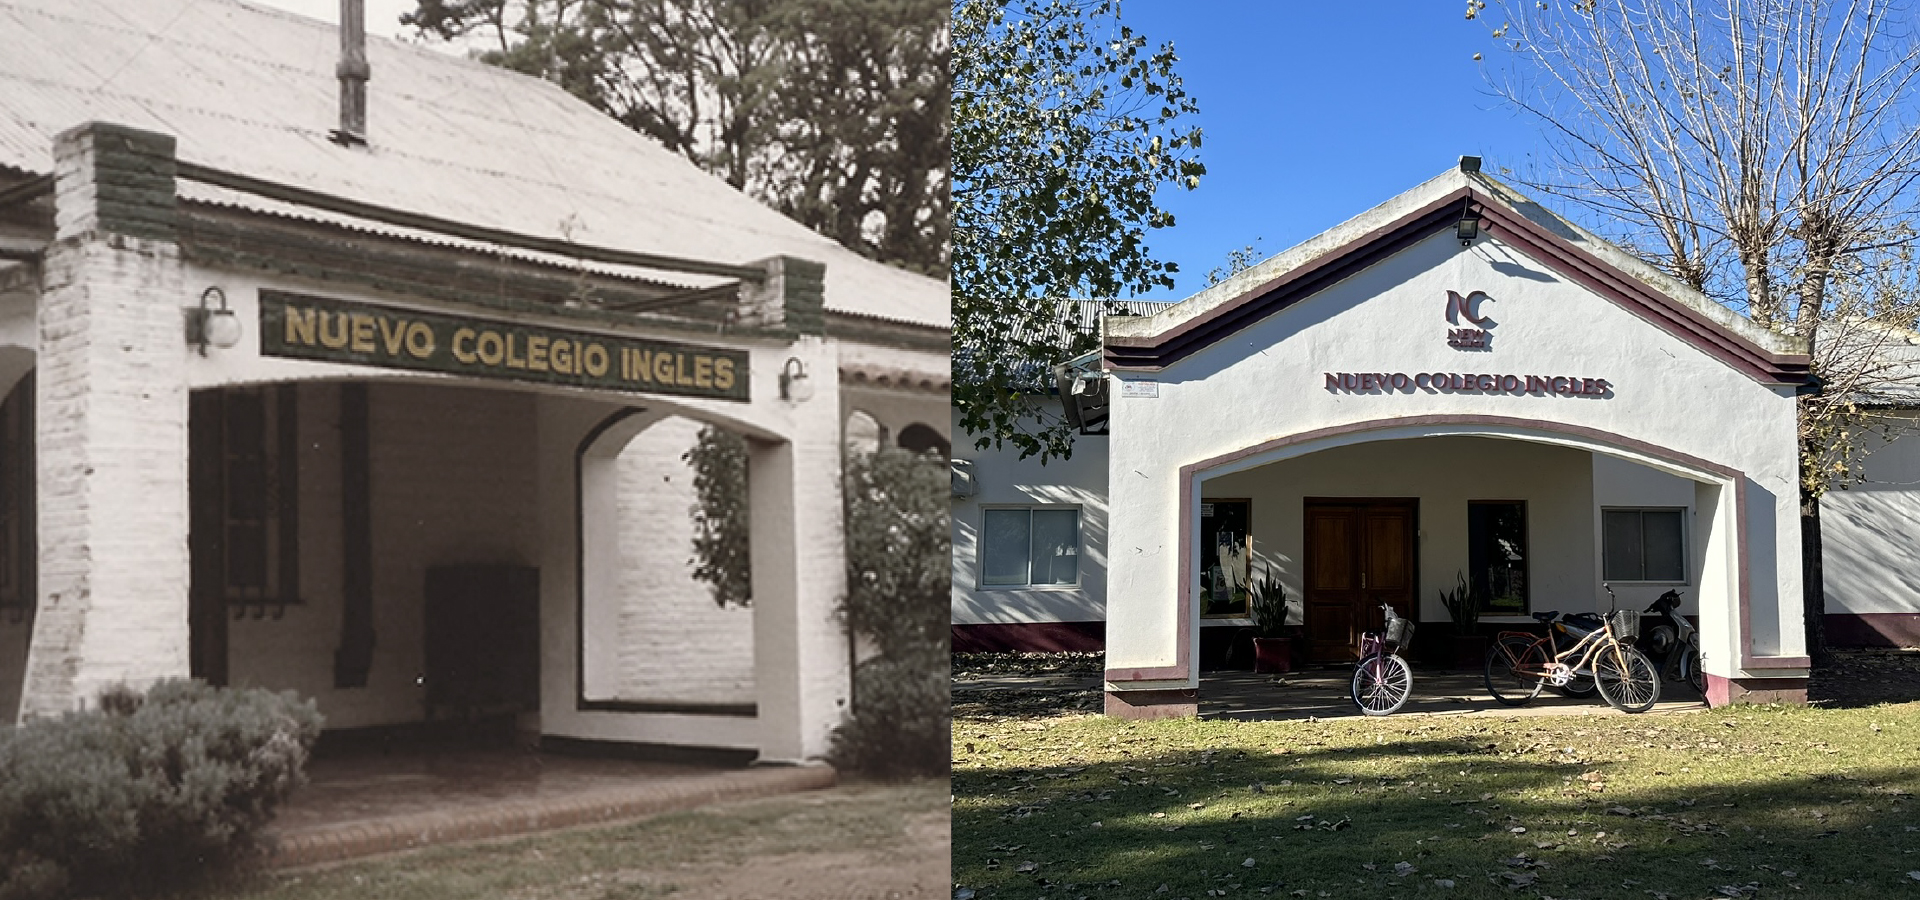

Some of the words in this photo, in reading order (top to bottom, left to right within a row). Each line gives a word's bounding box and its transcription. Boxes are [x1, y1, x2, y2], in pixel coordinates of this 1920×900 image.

[1447, 329, 1487, 340] NEW
[285, 306, 436, 358] NUEVO
[451, 328, 610, 377] COLEGIO
[621, 347, 735, 389] INGLES
[1324, 372, 1409, 391] NUEVO
[1414, 372, 1519, 393] COLEGIO
[1524, 375, 1609, 396] INGLES
